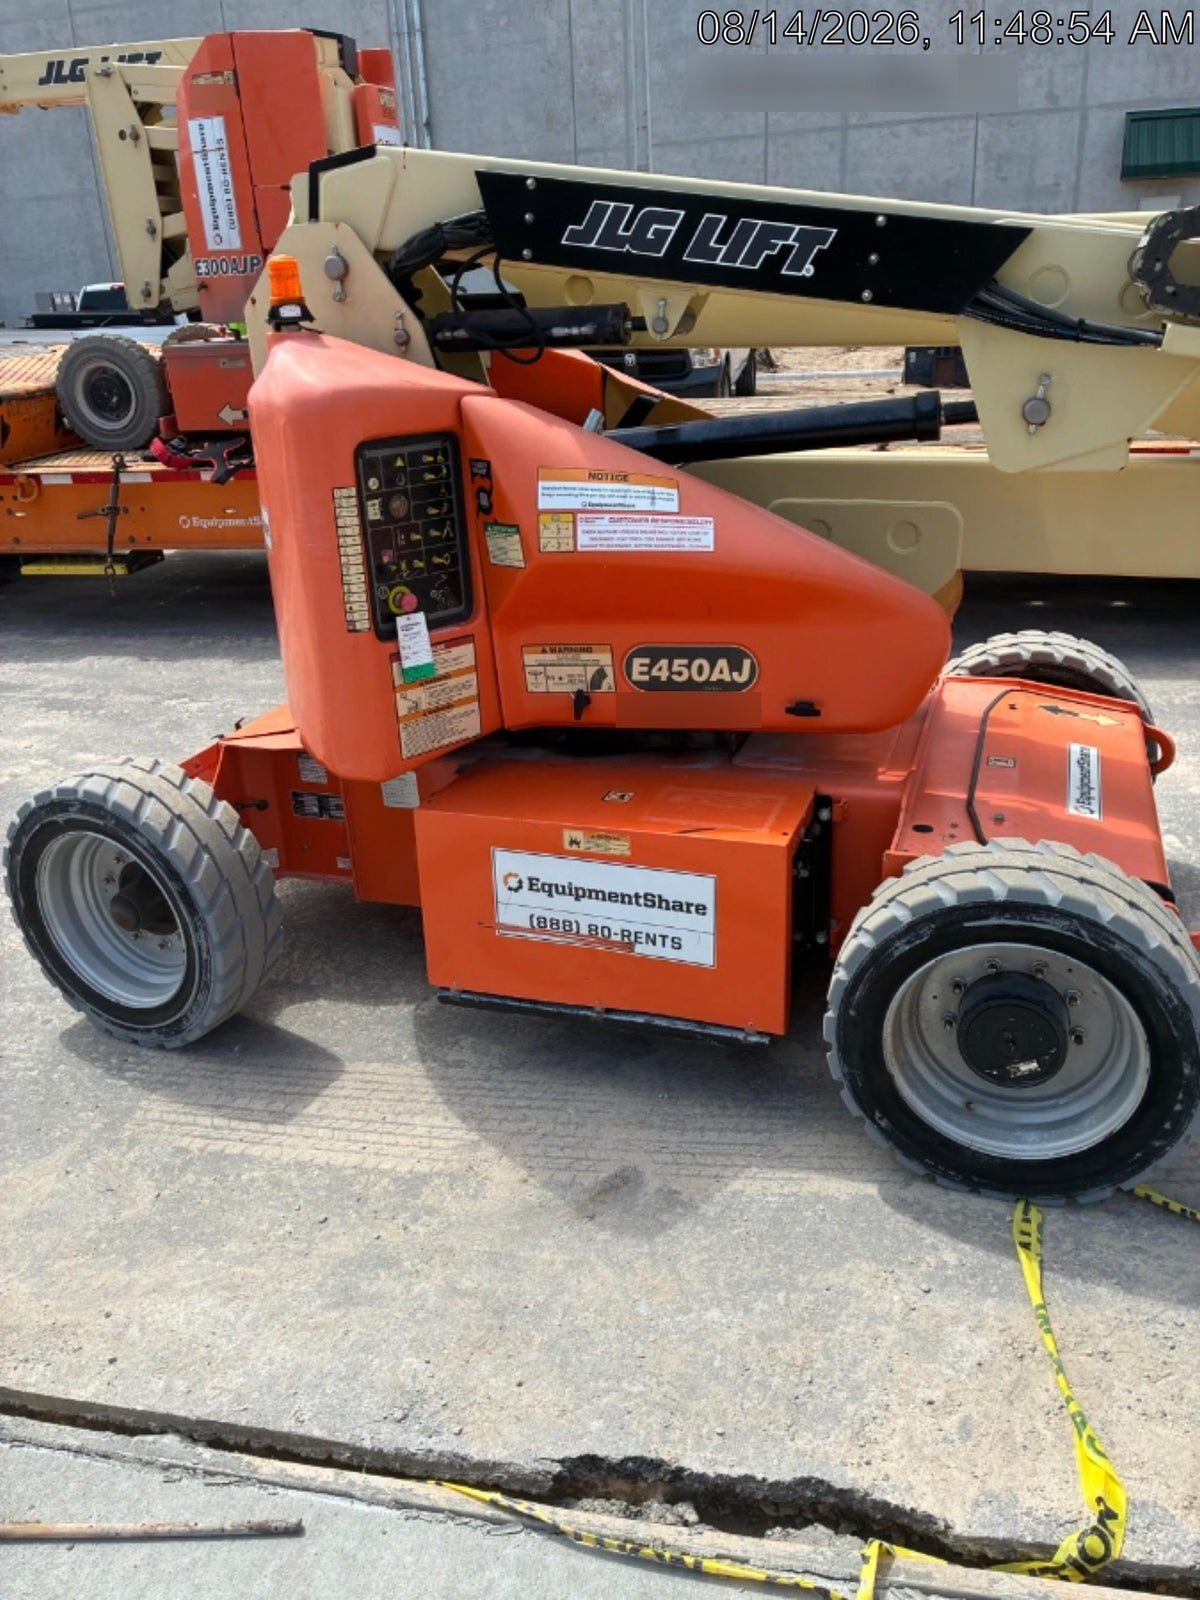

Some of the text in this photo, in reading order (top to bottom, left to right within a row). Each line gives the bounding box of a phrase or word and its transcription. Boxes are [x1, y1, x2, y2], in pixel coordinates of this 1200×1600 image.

[560, 200, 838, 276] JLG LIFT
[194, 256, 262, 277] E300AJP
[588, 472, 629, 482] NOTICE
[631, 657, 752, 684] E450AJ
[527, 876, 708, 917] EquipmentShare
[529, 913, 683, 951] (888) 80-RENTS
